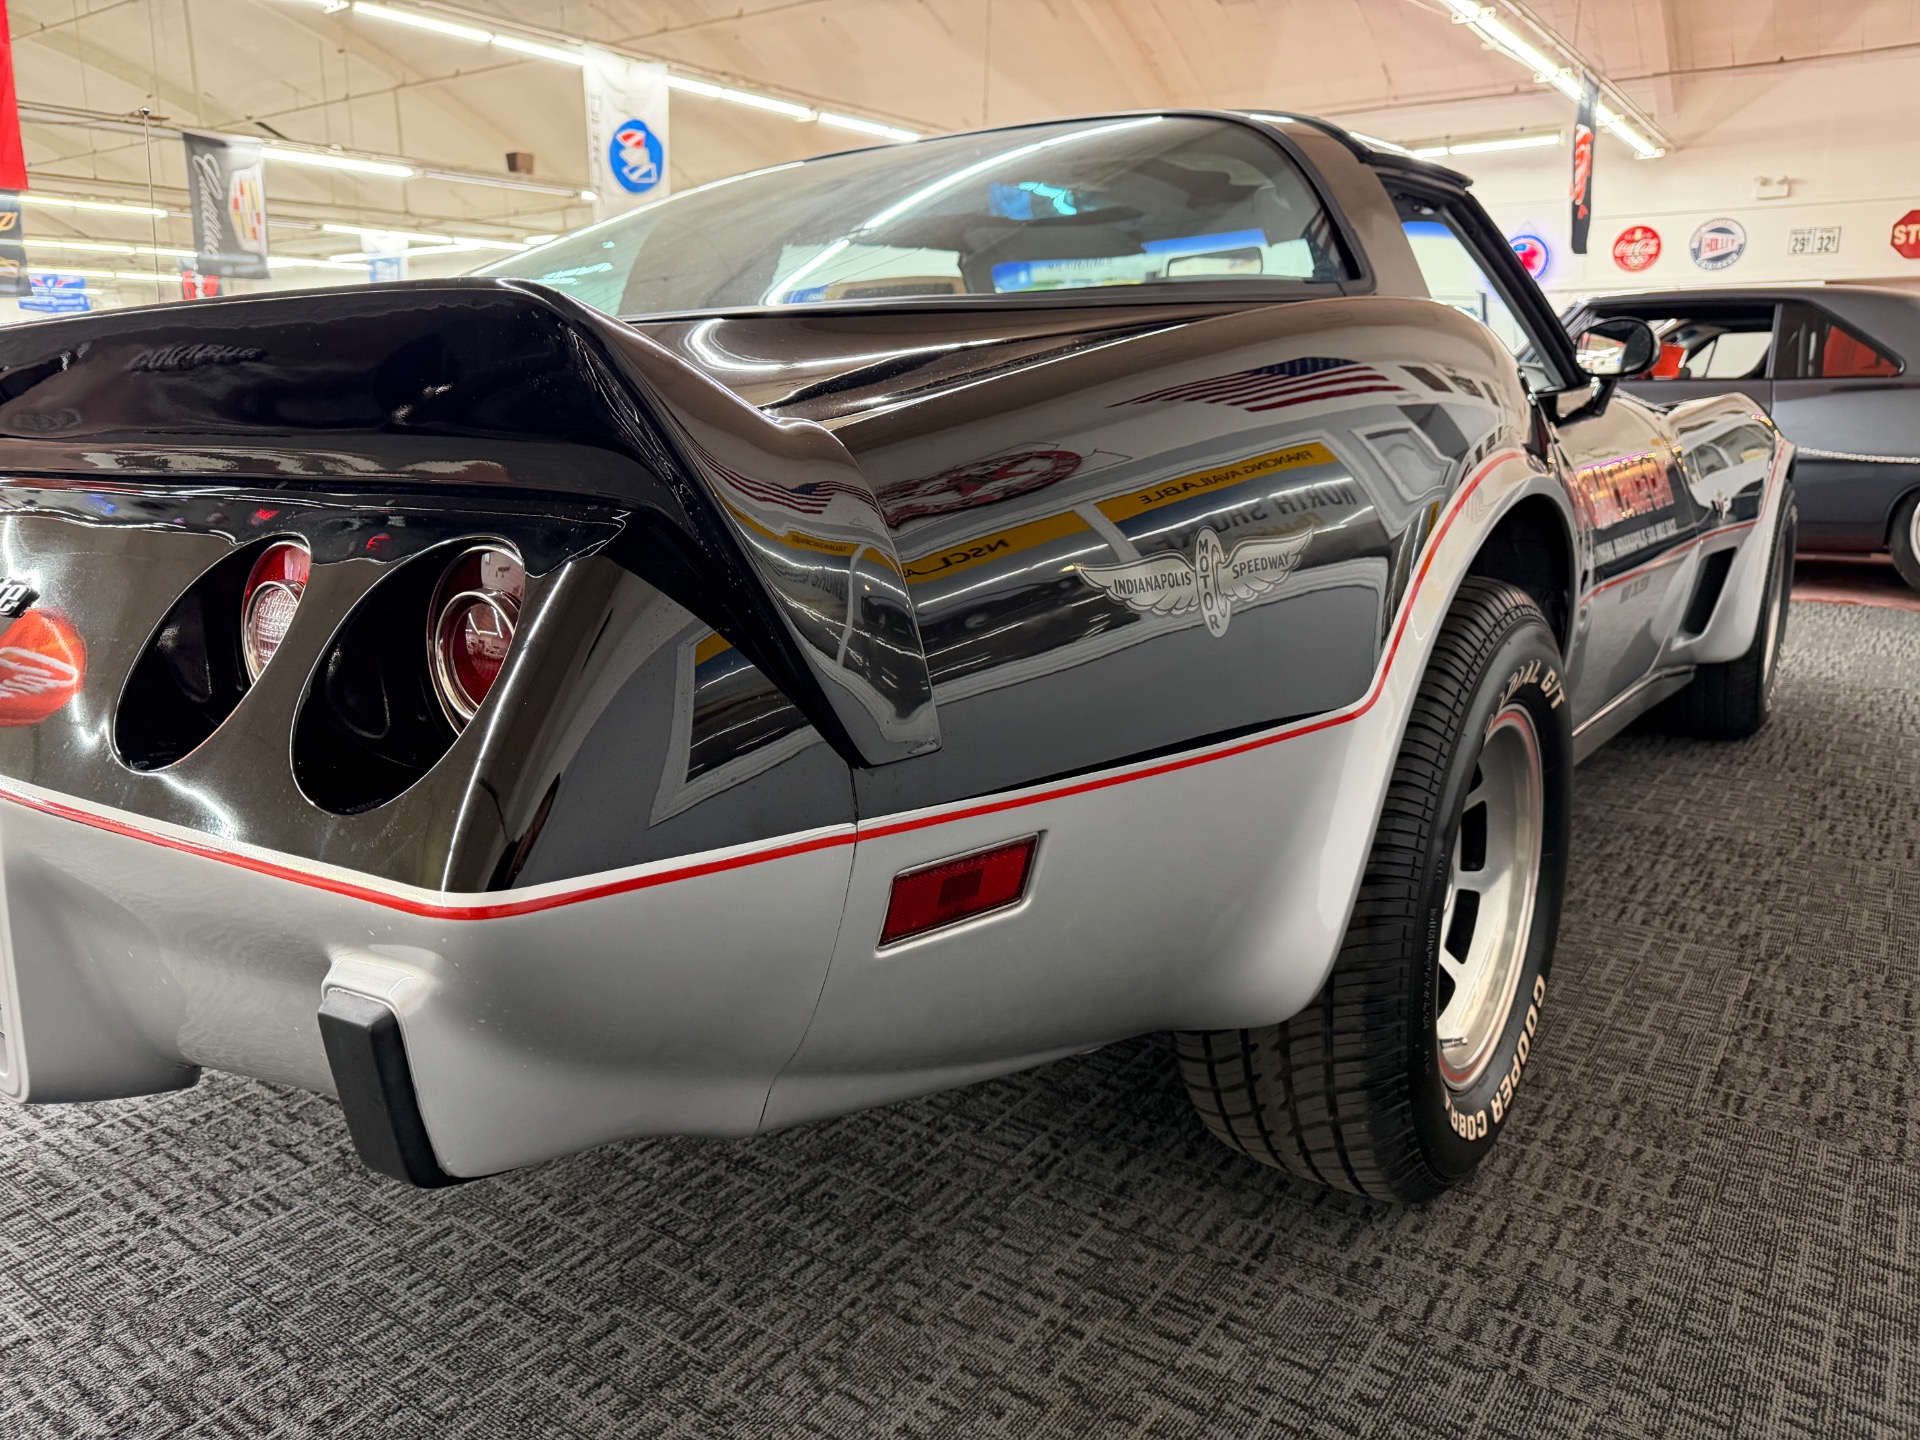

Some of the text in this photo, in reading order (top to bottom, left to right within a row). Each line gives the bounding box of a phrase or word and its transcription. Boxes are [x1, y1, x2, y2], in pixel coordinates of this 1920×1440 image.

[1894, 224, 1920, 245] ST
[1113, 538, 1290, 630] INDIANAPOLIS MOTOR SPEEDWAY
[1540, 666, 1565, 709] G/T
[1490, 974, 1546, 1124] COOPER
